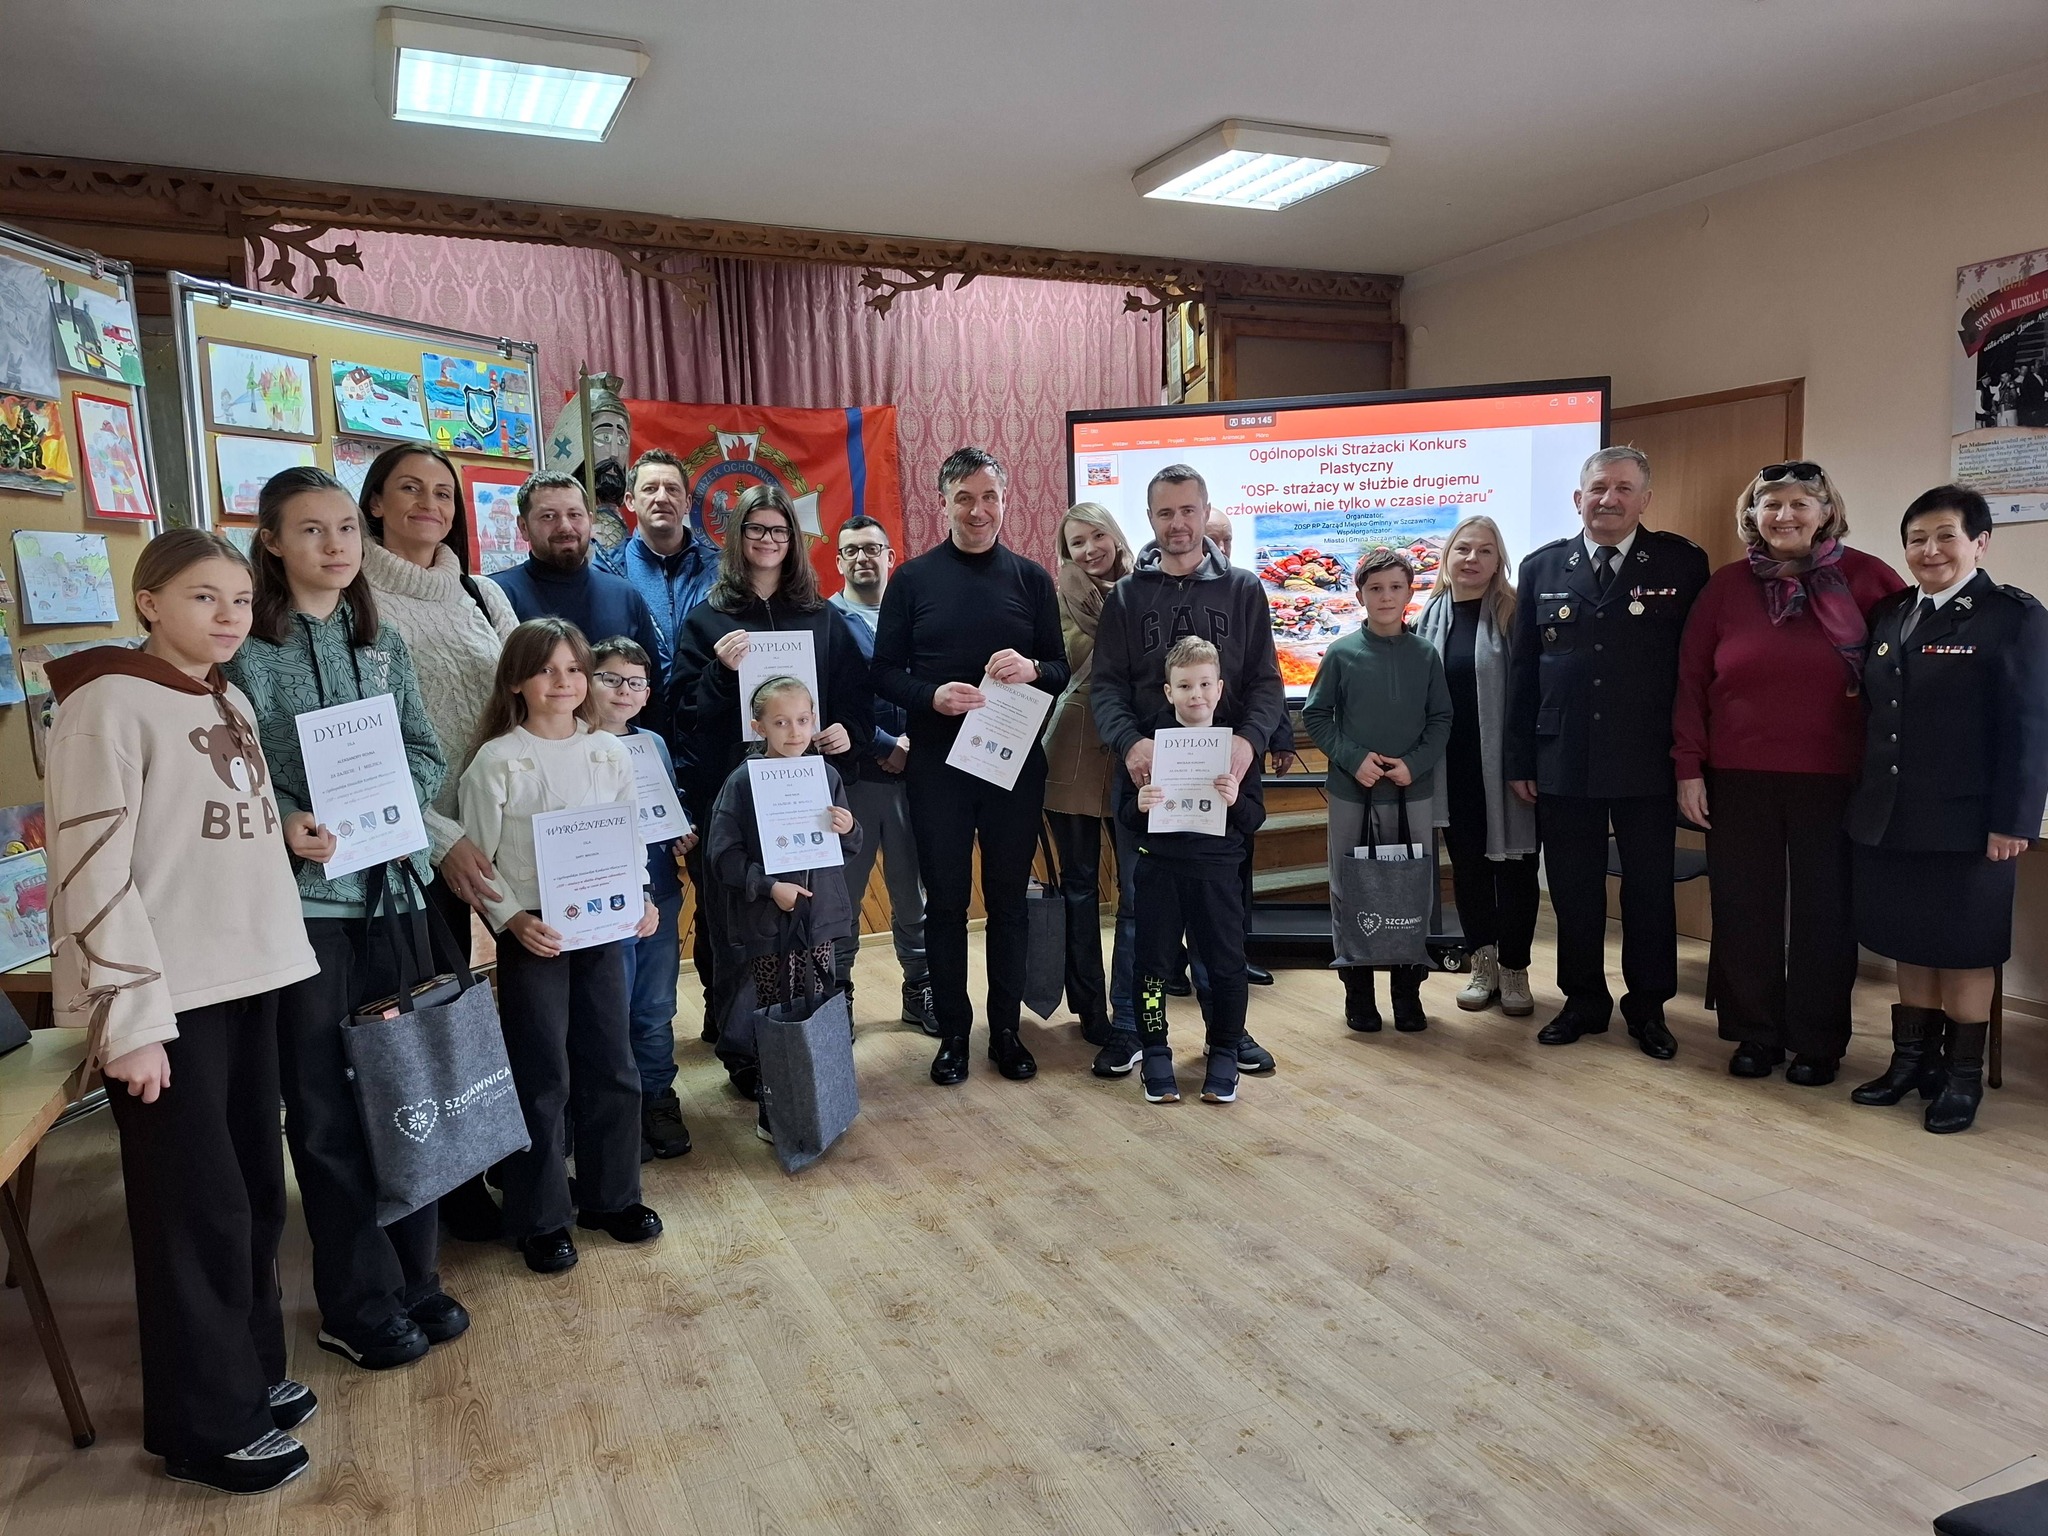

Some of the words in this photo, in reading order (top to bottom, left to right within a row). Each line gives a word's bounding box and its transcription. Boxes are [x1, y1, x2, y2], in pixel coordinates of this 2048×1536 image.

[1975, 303, 2005, 331] SZTUKI
[1241, 417, 1256, 425] 550
[1257, 416, 1272, 424] 145
[1249, 444, 1338, 463] Ogólnopolski
[1342, 440, 1404, 455] Strażacki
[1409, 437, 1467, 451] Konkurs
[723, 463, 779, 488] OCHOTNICZ
[1320, 461, 1393, 476] Plastyczny
[1283, 481, 1339, 495] strażacy
[1344, 482, 1355, 491] w
[1359, 477, 1409, 490] służbie
[1413, 474, 1480, 489] drugiemu
[1226, 500, 1311, 516] człowiekowi,
[1314, 499, 1335, 511] nie
[1338, 497, 1370, 513] tylko
[1375, 498, 1386, 507] w
[1390, 494, 1435, 507] czasie
[1322, 521, 1343, 529] Zarząd
[1141, 605, 1230, 656] GAP
[748, 641, 802, 653] DYPLOM
[313, 714, 383, 743] DYPLOM
[1164, 738, 1219, 749] DYPLOM
[760, 768, 814, 781] DYPLOM
[546, 816, 627, 836] WYRÓŻNIENIE
[444, 1066, 511, 1110] SZCZAWNICA
